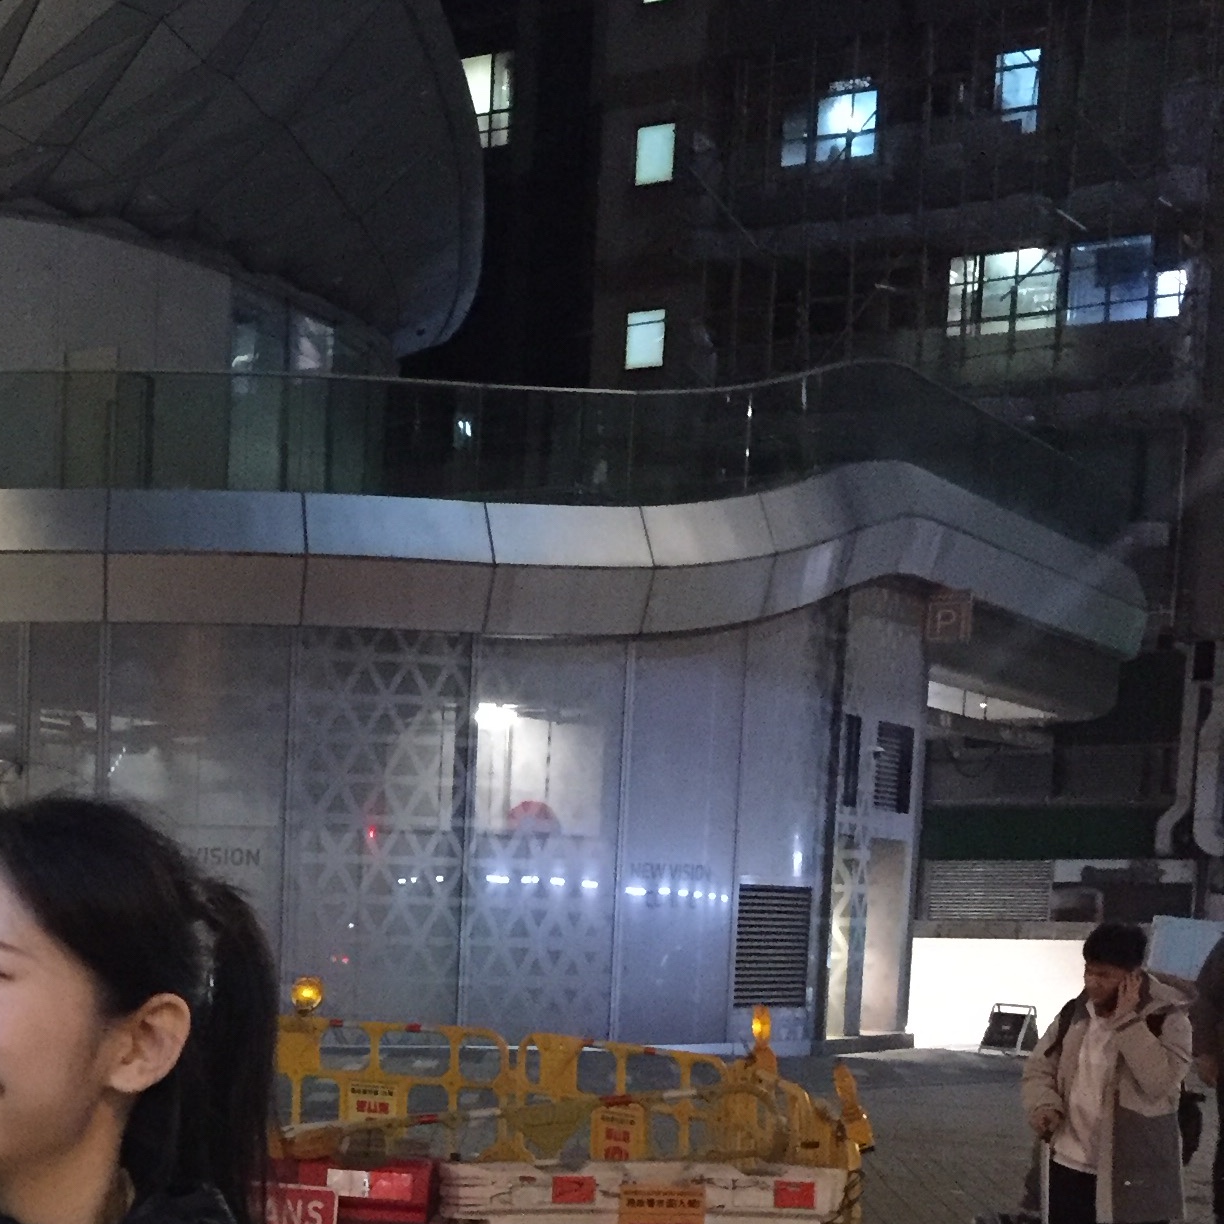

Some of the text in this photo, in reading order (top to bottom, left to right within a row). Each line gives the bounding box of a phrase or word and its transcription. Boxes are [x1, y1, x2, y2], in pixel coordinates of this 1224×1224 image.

[936, 609, 956, 634] P
[630, 862, 712, 881] NEW VISION
